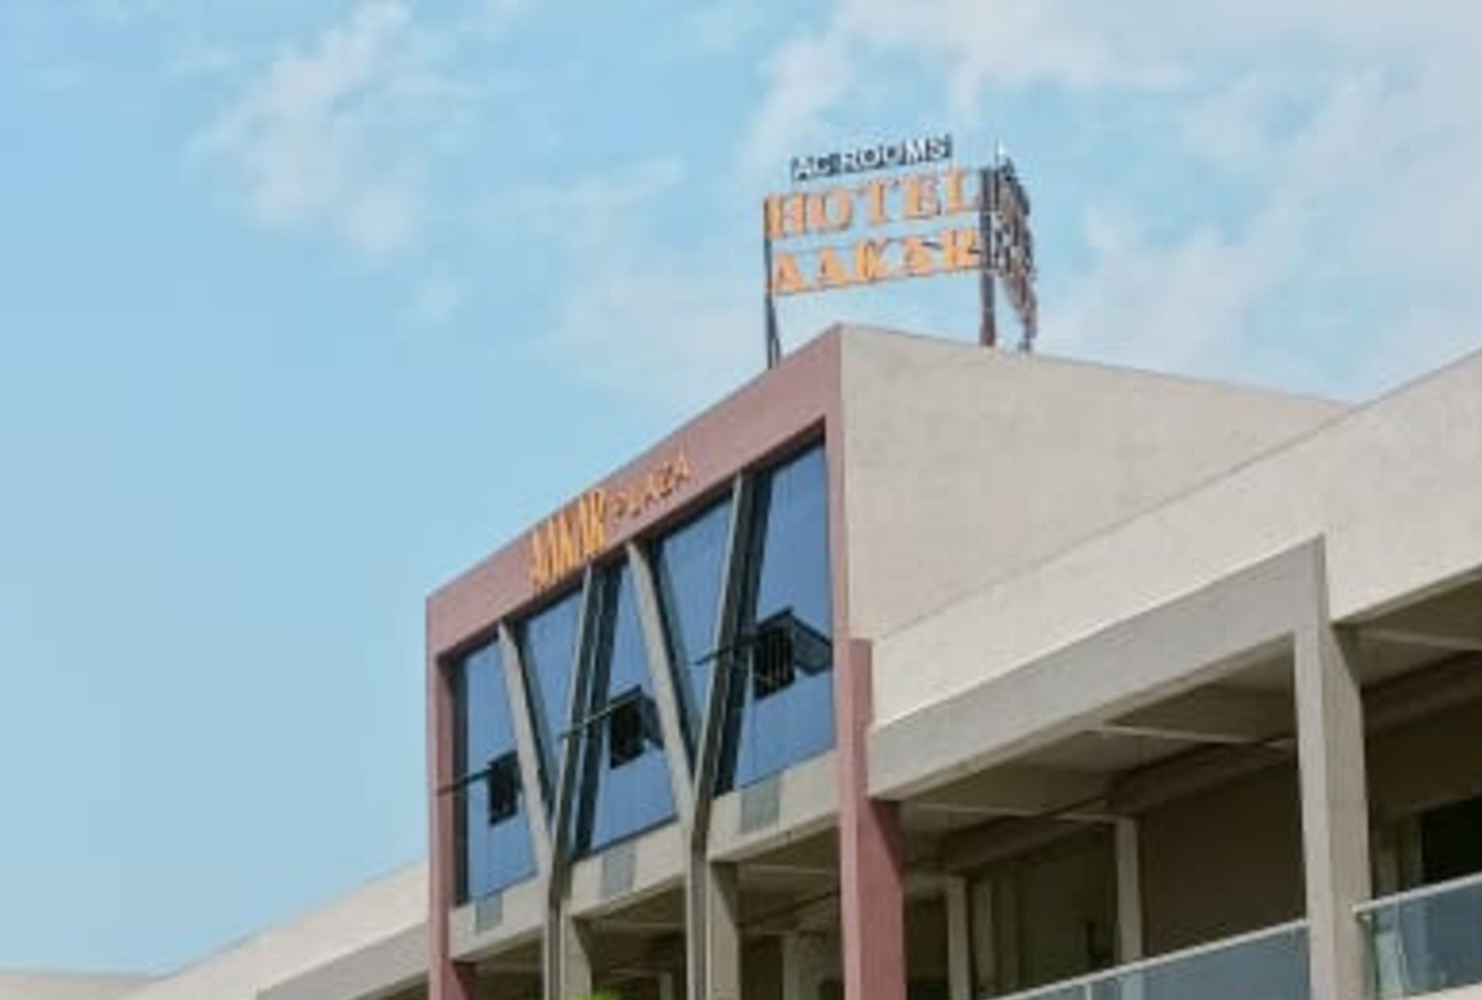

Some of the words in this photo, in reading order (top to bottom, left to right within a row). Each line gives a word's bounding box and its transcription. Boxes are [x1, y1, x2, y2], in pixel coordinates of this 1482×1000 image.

[841, 134, 952, 176] ROOMS
[764, 168, 978, 239] HOTEL
[770, 225, 979, 296] AAKAR
